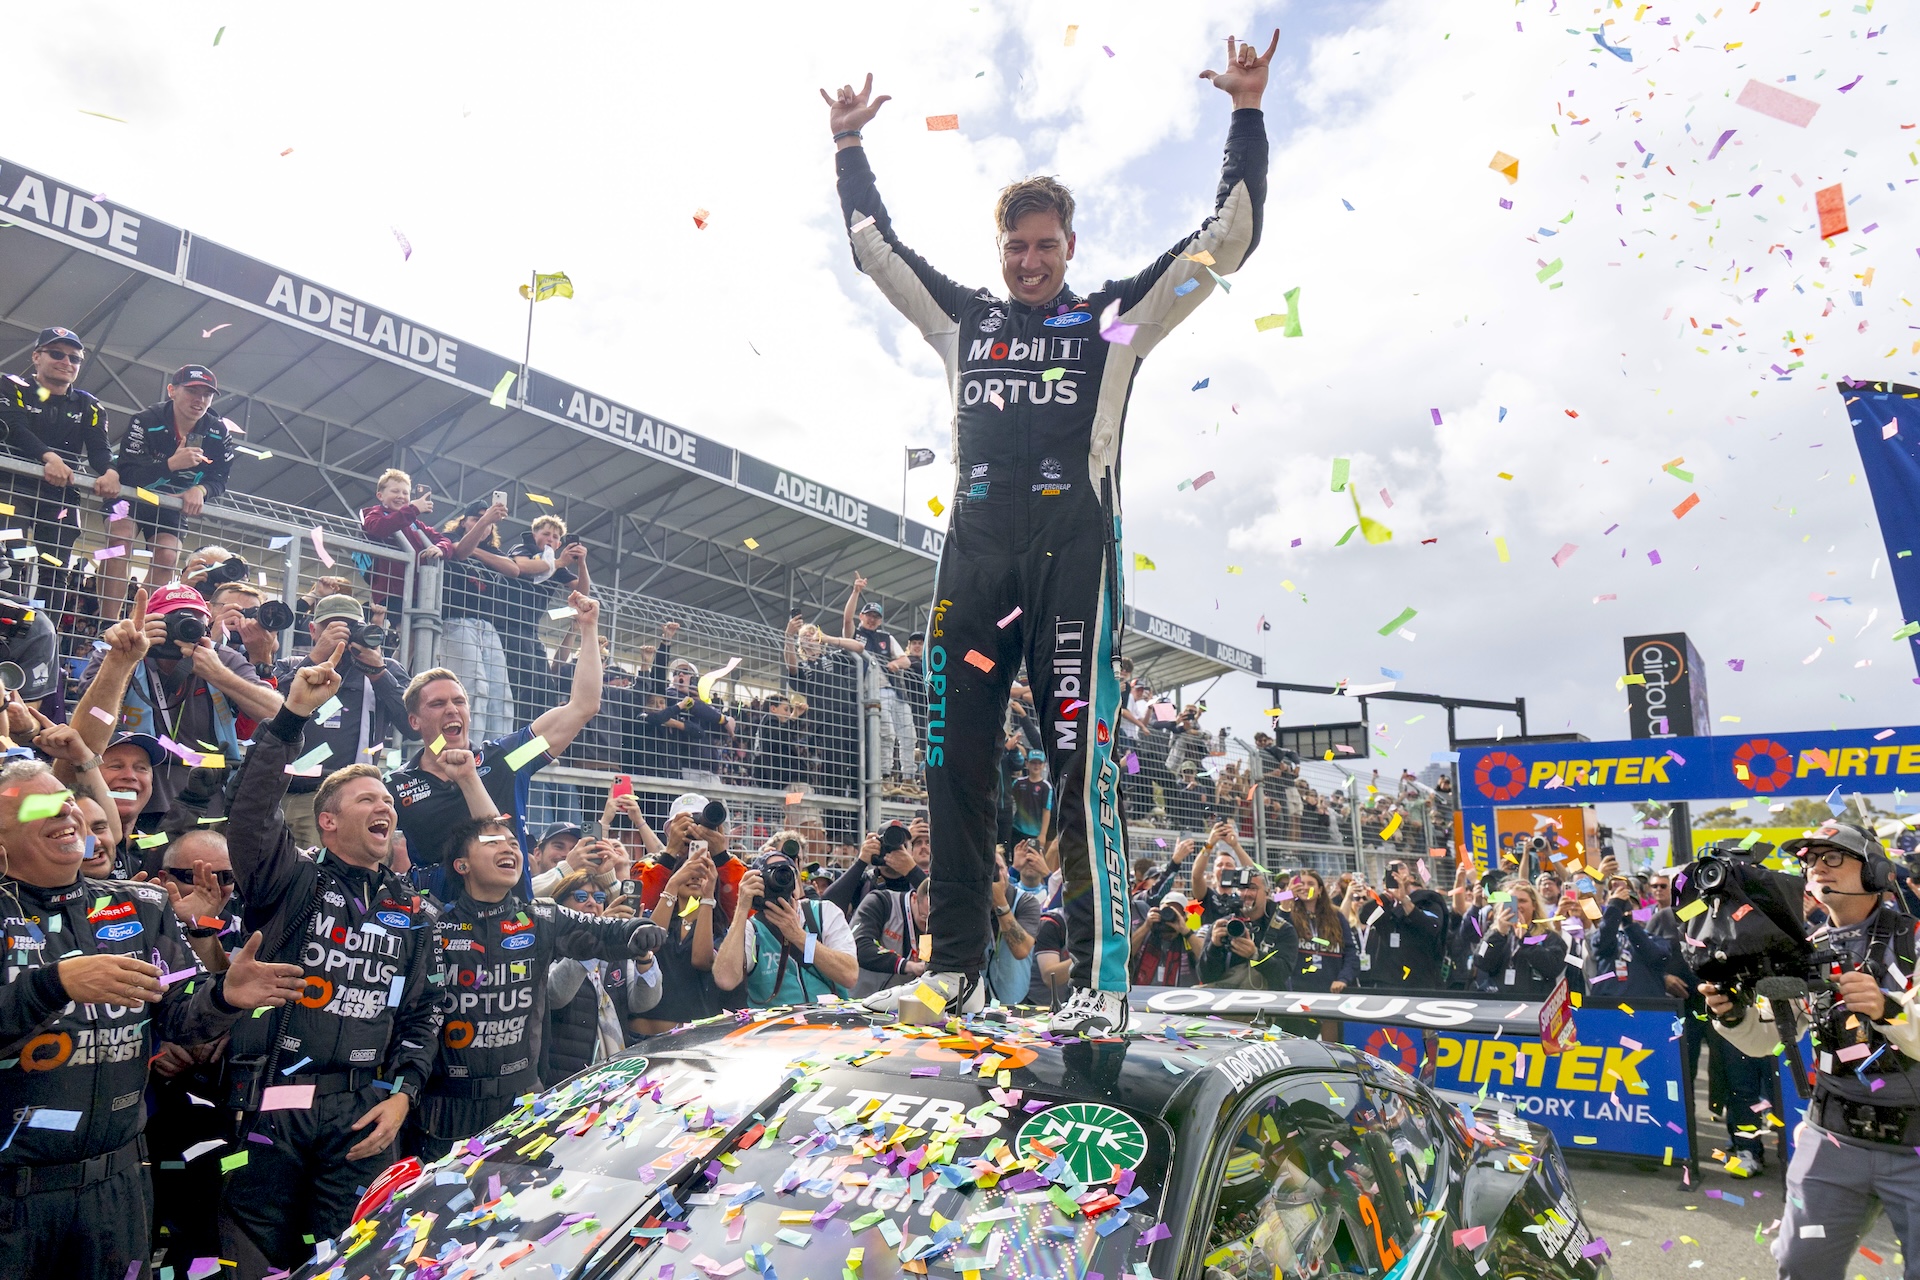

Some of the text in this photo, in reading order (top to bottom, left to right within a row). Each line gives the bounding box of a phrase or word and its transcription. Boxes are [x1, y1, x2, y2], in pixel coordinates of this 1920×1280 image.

[0, 173, 141, 256] AIDE
[265, 273, 458, 374] ADELAIDE
[967, 337, 1046, 361] Mobil
[964, 378, 1078, 405] OPTUS
[566, 390, 697, 464] ADELAIDE
[971, 466, 989, 476] OMP
[773, 471, 868, 528] ADELAIDE
[1032, 483, 1071, 492] SUPERCHEAP
[1148, 617, 1191, 647] ADELAIDE
[1216, 644, 1252, 669] ADELAIDE
[926, 645, 947, 768] OPTUS
[1053, 658, 1082, 750] Mobil
[1528, 756, 1675, 788] PIRTEK
[396, 778, 418, 792] Mobil
[399, 783, 430, 798] OPTUS
[91, 905, 132, 919] MORRIS
[421, 899, 438, 916] OMP
[478, 907, 498, 918] Mobil
[315, 912, 375, 953] Mobil
[13, 942, 46, 951] ASSIST
[446, 943, 472, 951] ASSIST
[303, 941, 398, 985] OPTUS
[444, 963, 506, 986] Mobil
[335, 984, 388, 1006] TRUCK
[444, 986, 533, 1015] OPTUS
[1146, 988, 1479, 1026] OPTUS
[322, 1001, 386, 1019] ASSIST
[77, 1023, 144, 1048] TRUCK
[476, 1014, 528, 1035] TRUCK
[470, 1028, 525, 1050] ASSIST
[66, 1040, 143, 1068] ASSIST
[1436, 1037, 1655, 1096] PIRTEK
[450, 1068, 469, 1077] OMP
[1215, 1041, 1292, 1094] LOCTITE
[1583, 1101, 1650, 1125] LANE
[1041, 1118, 1131, 1152] NTK
